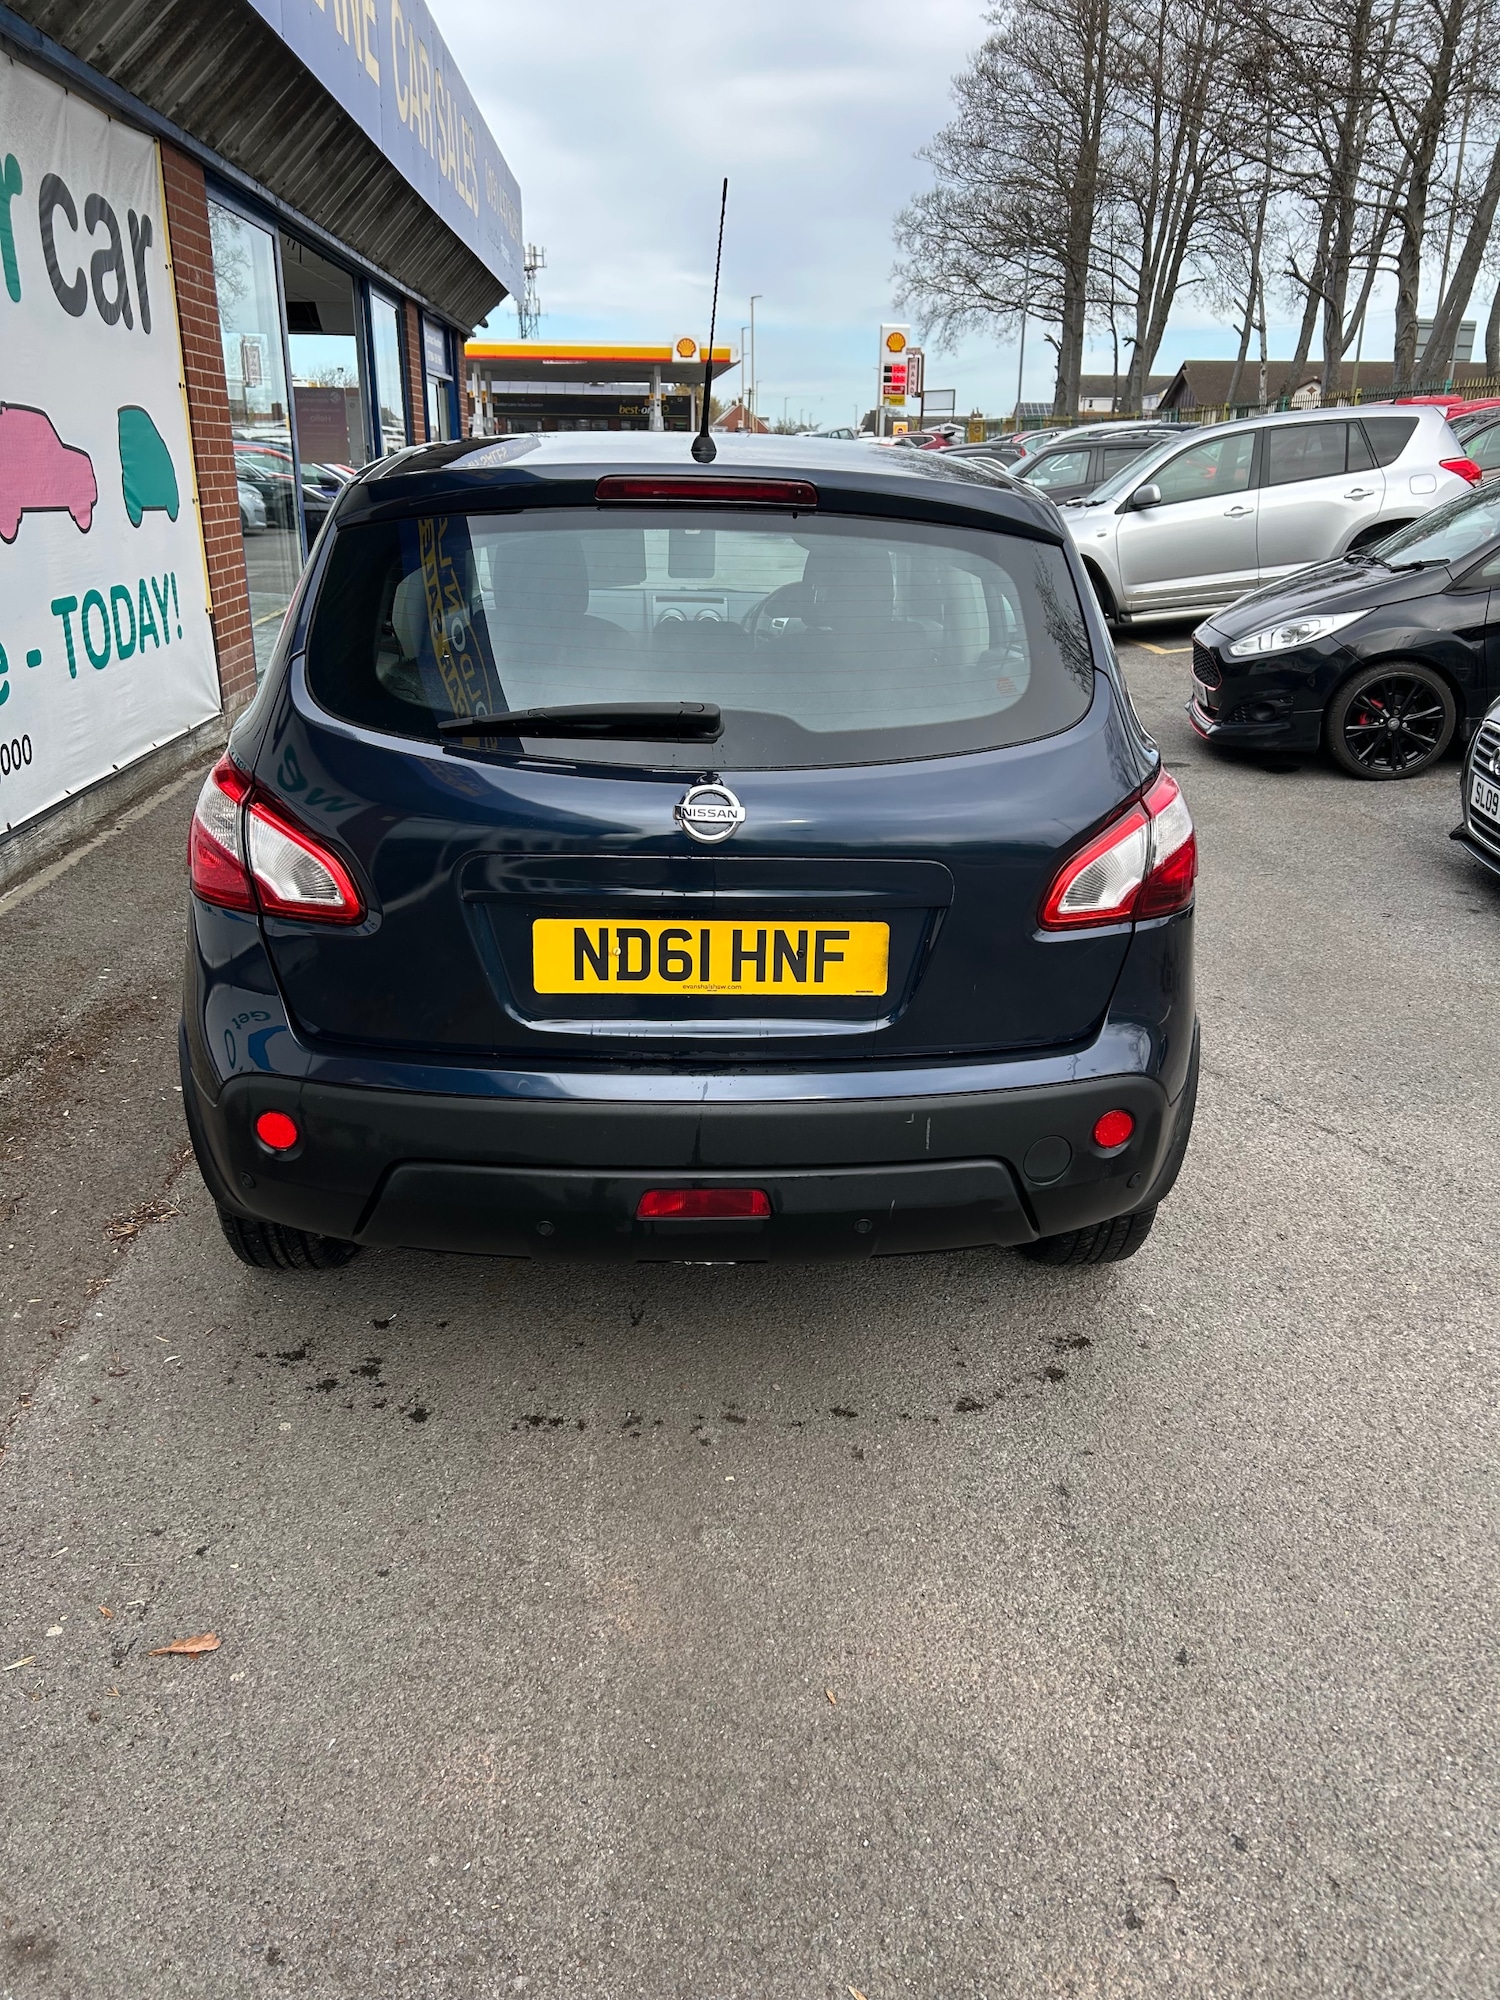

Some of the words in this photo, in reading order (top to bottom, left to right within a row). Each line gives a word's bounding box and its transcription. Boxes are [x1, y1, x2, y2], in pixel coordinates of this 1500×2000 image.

[390, 0, 435, 160] CAR
[434, 67, 480, 218] SALES
[38, 172, 153, 335] car
[50, 572, 183, 679] TODAY!
[0, 734, 32, 776] 000
[683, 807, 738, 819] NISSAN
[1475, 782, 1499, 816] SL09
[573, 928, 710, 981] ND61
[732, 929, 850, 982] HNF
